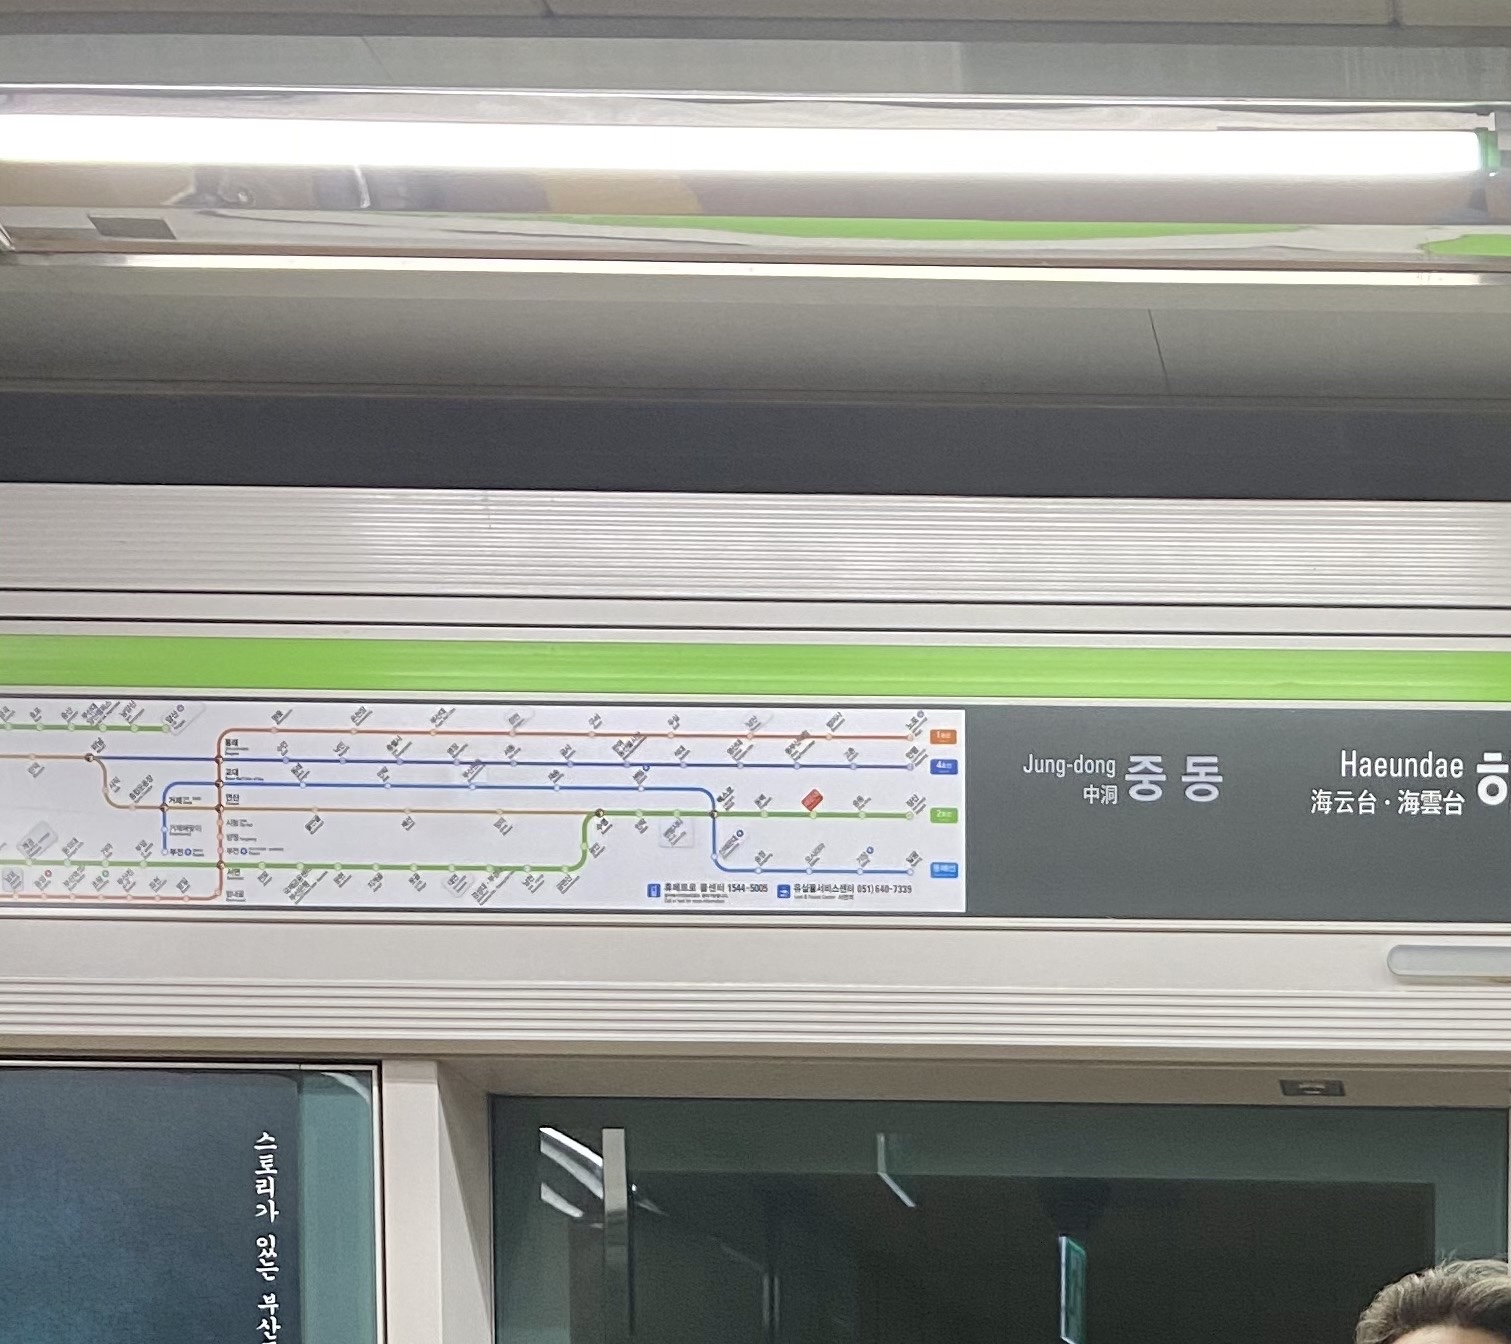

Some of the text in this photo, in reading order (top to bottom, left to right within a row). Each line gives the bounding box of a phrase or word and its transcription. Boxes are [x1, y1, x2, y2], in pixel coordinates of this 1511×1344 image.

[1023, 753, 1116, 779] Jung-dong
[1341, 750, 1464, 778] Haeundae
[1082, 783, 1119, 807] 中洞
[254, 1131, 280, 1223] 스토리가
[256, 1234, 280, 1281] 있는
